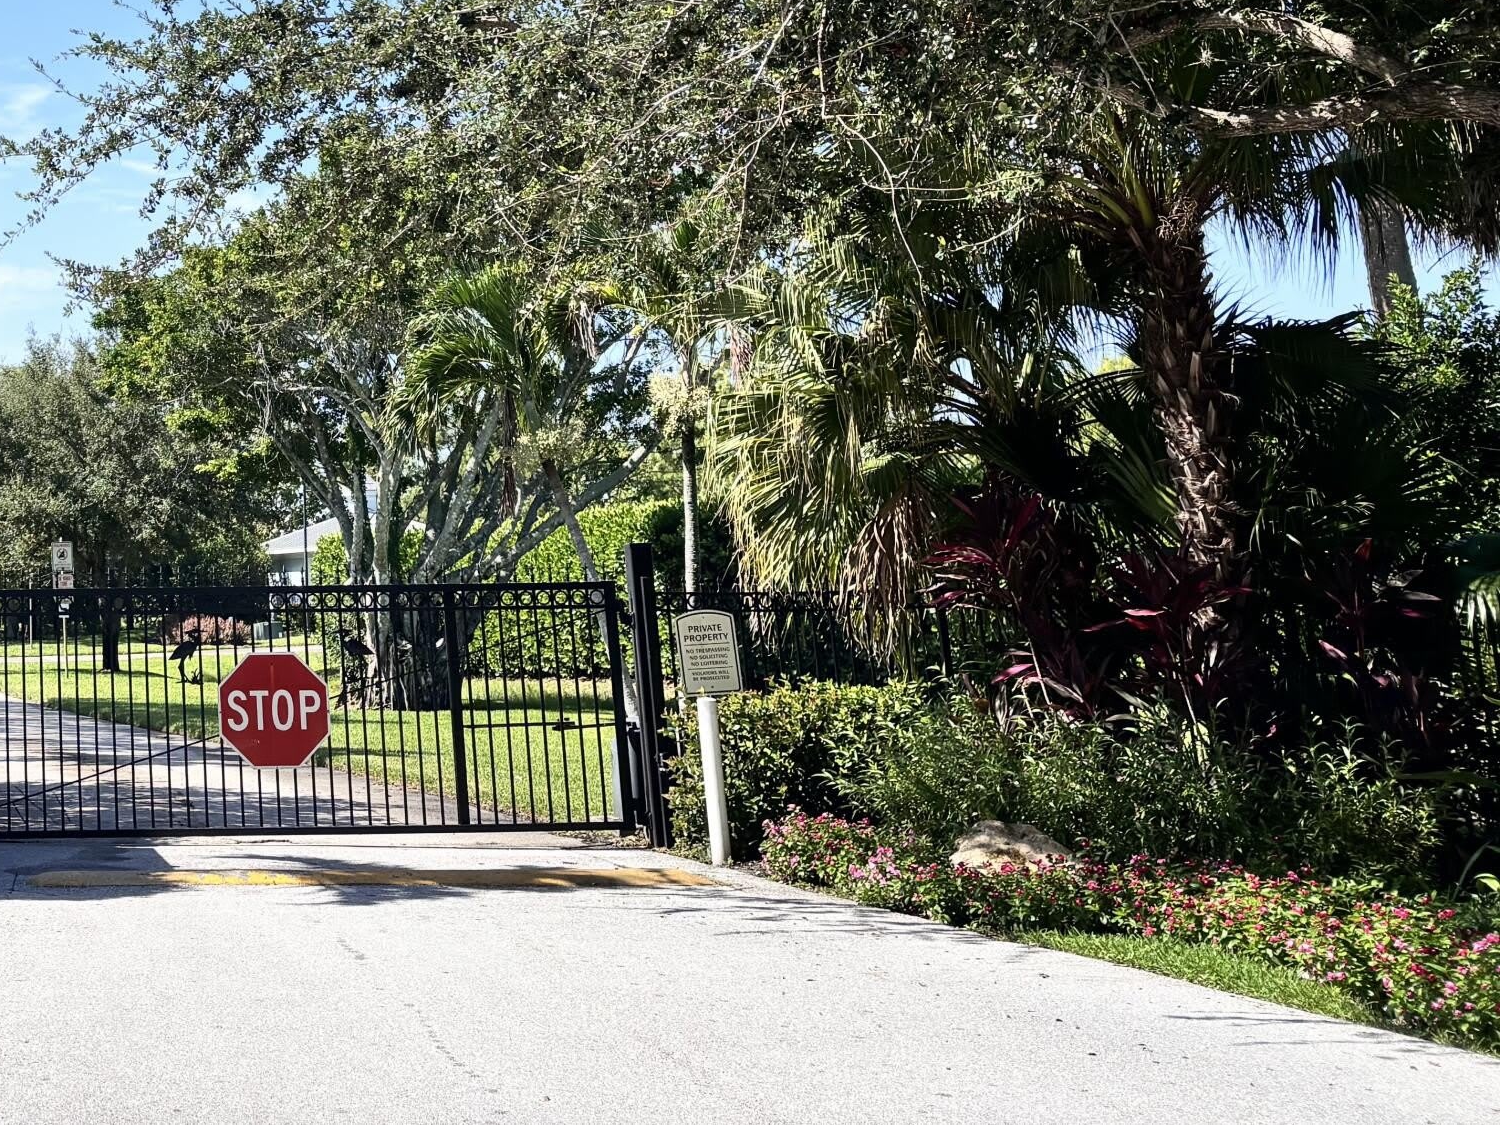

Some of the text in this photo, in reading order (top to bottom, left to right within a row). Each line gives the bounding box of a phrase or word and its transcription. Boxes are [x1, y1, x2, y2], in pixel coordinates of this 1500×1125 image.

[688, 624, 722, 633] PRIVATE
[684, 633, 728, 642] PROPERTY
[227, 689, 321, 732] STOP
